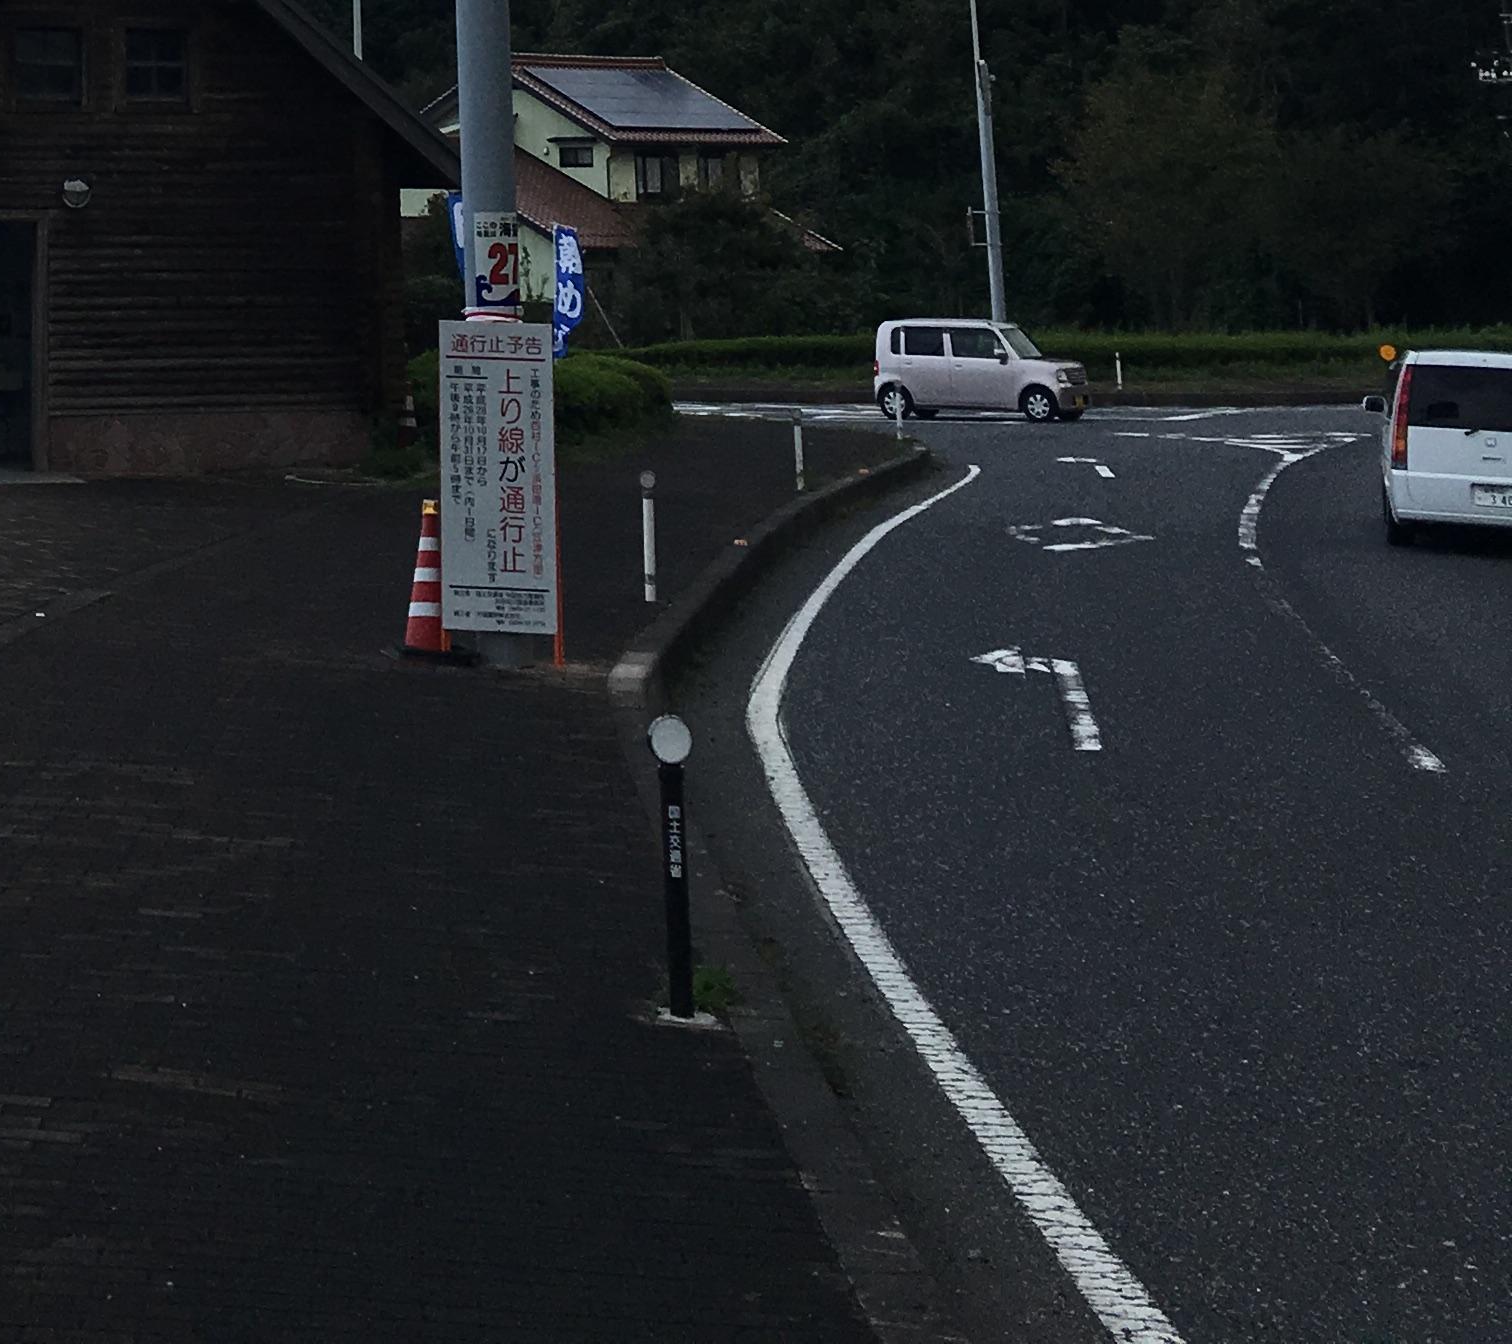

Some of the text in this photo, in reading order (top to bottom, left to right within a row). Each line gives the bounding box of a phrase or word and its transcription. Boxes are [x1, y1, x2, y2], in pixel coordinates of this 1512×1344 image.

[451, 333, 543, 356] 通行止予告
[498, 368, 526, 574] 上り線が通行止
